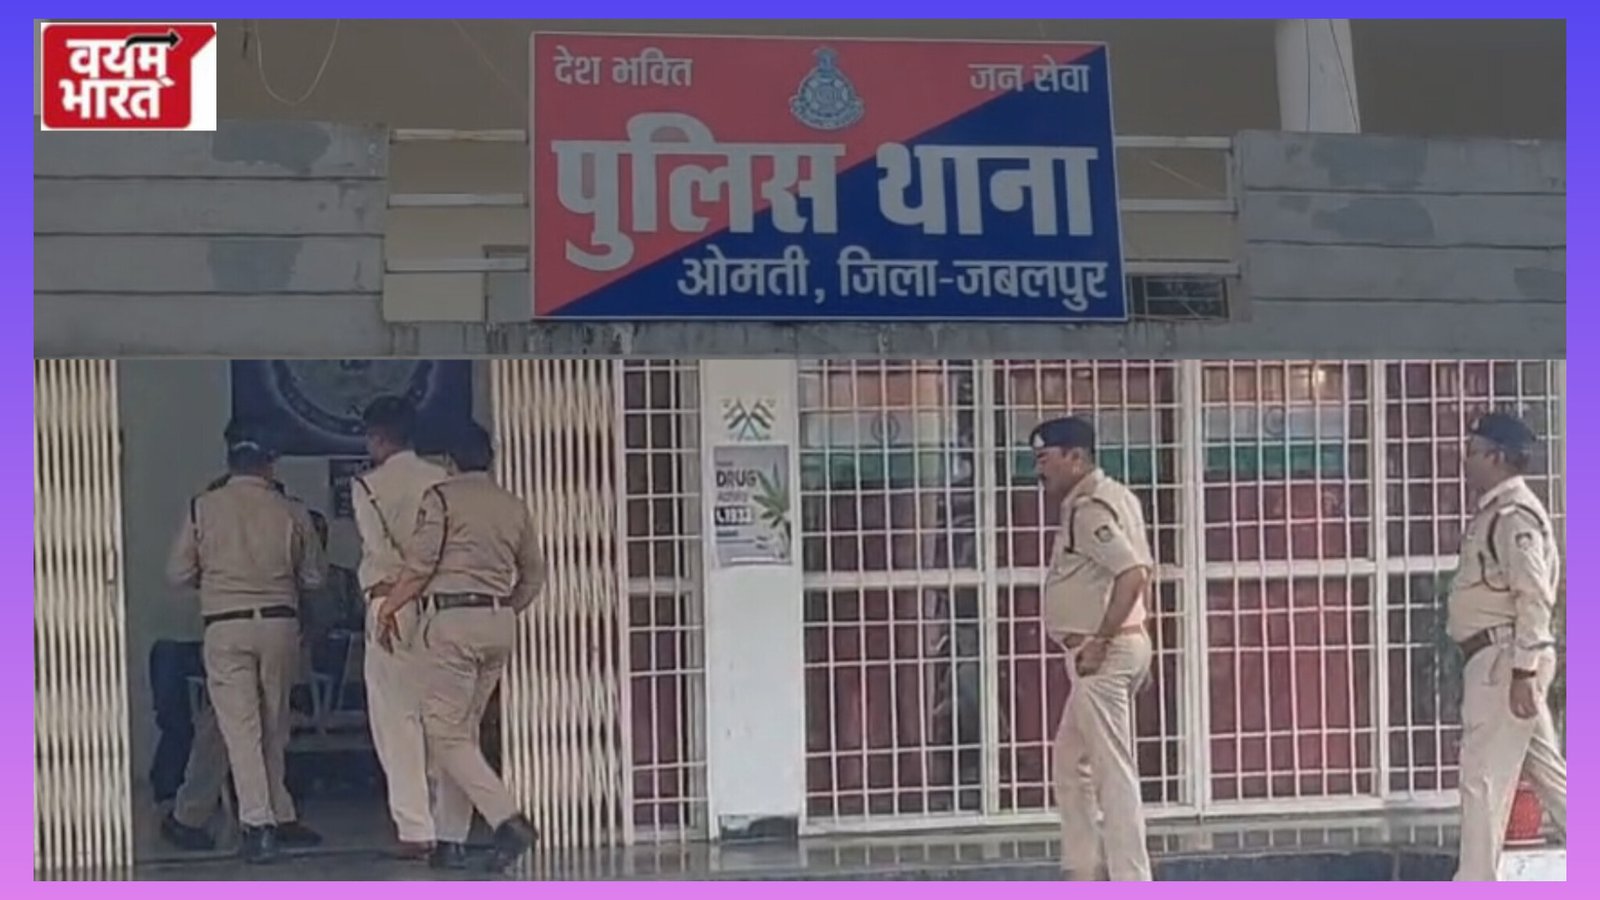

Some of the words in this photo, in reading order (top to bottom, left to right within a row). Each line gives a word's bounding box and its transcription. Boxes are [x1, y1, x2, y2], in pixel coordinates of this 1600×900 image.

[553, 45, 601, 85] देश
[612, 47, 693, 87] भक्ति
[968, 63, 1023, 92] जन
[1033, 54, 1090, 93] सेवा
[551, 112, 846, 271] पुलिस
[877, 142, 1098, 236] थाना
[677, 244, 826, 304] ओमती,
[836, 245, 1109, 312] जिला-जबलपुर
[716, 469, 757, 488] DRUG
